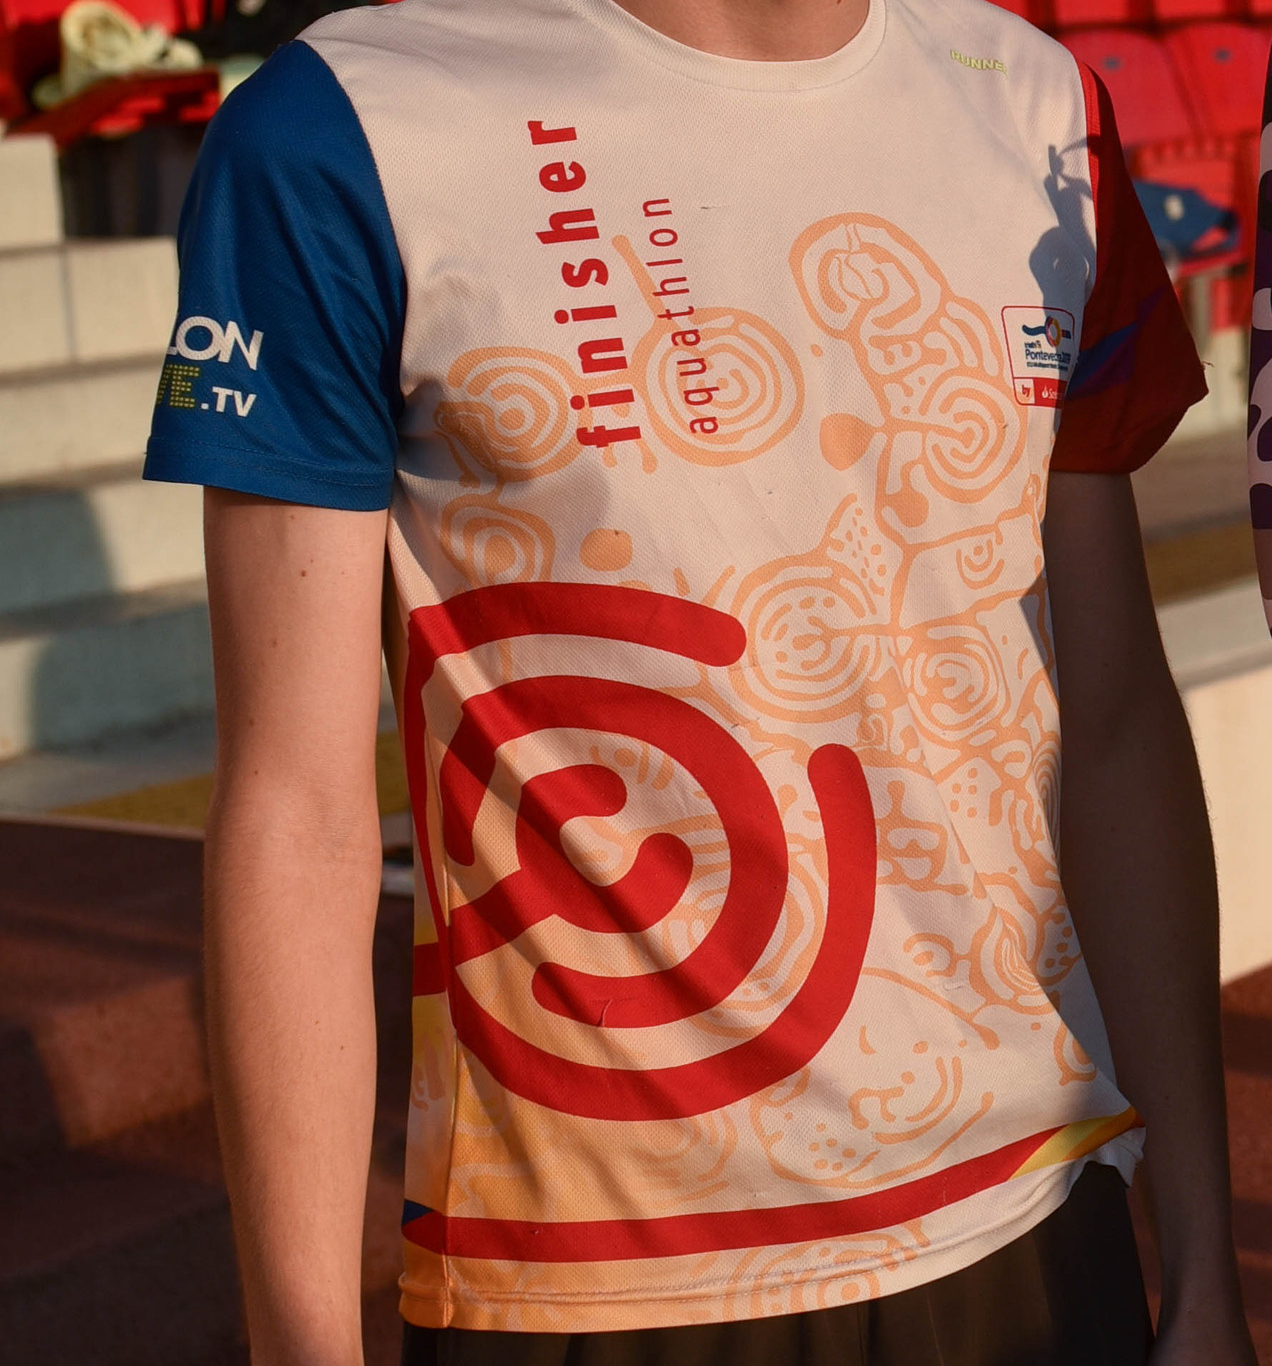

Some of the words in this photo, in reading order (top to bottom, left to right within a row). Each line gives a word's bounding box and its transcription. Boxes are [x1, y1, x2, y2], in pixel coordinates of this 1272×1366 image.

[950, 49, 1008, 76] RUNNE
[527, 120, 642, 448] finisher
[166, 316, 264, 371] ON
[642, 198, 720, 435] aquathlon
[1022, 384, 1031, 398] by
